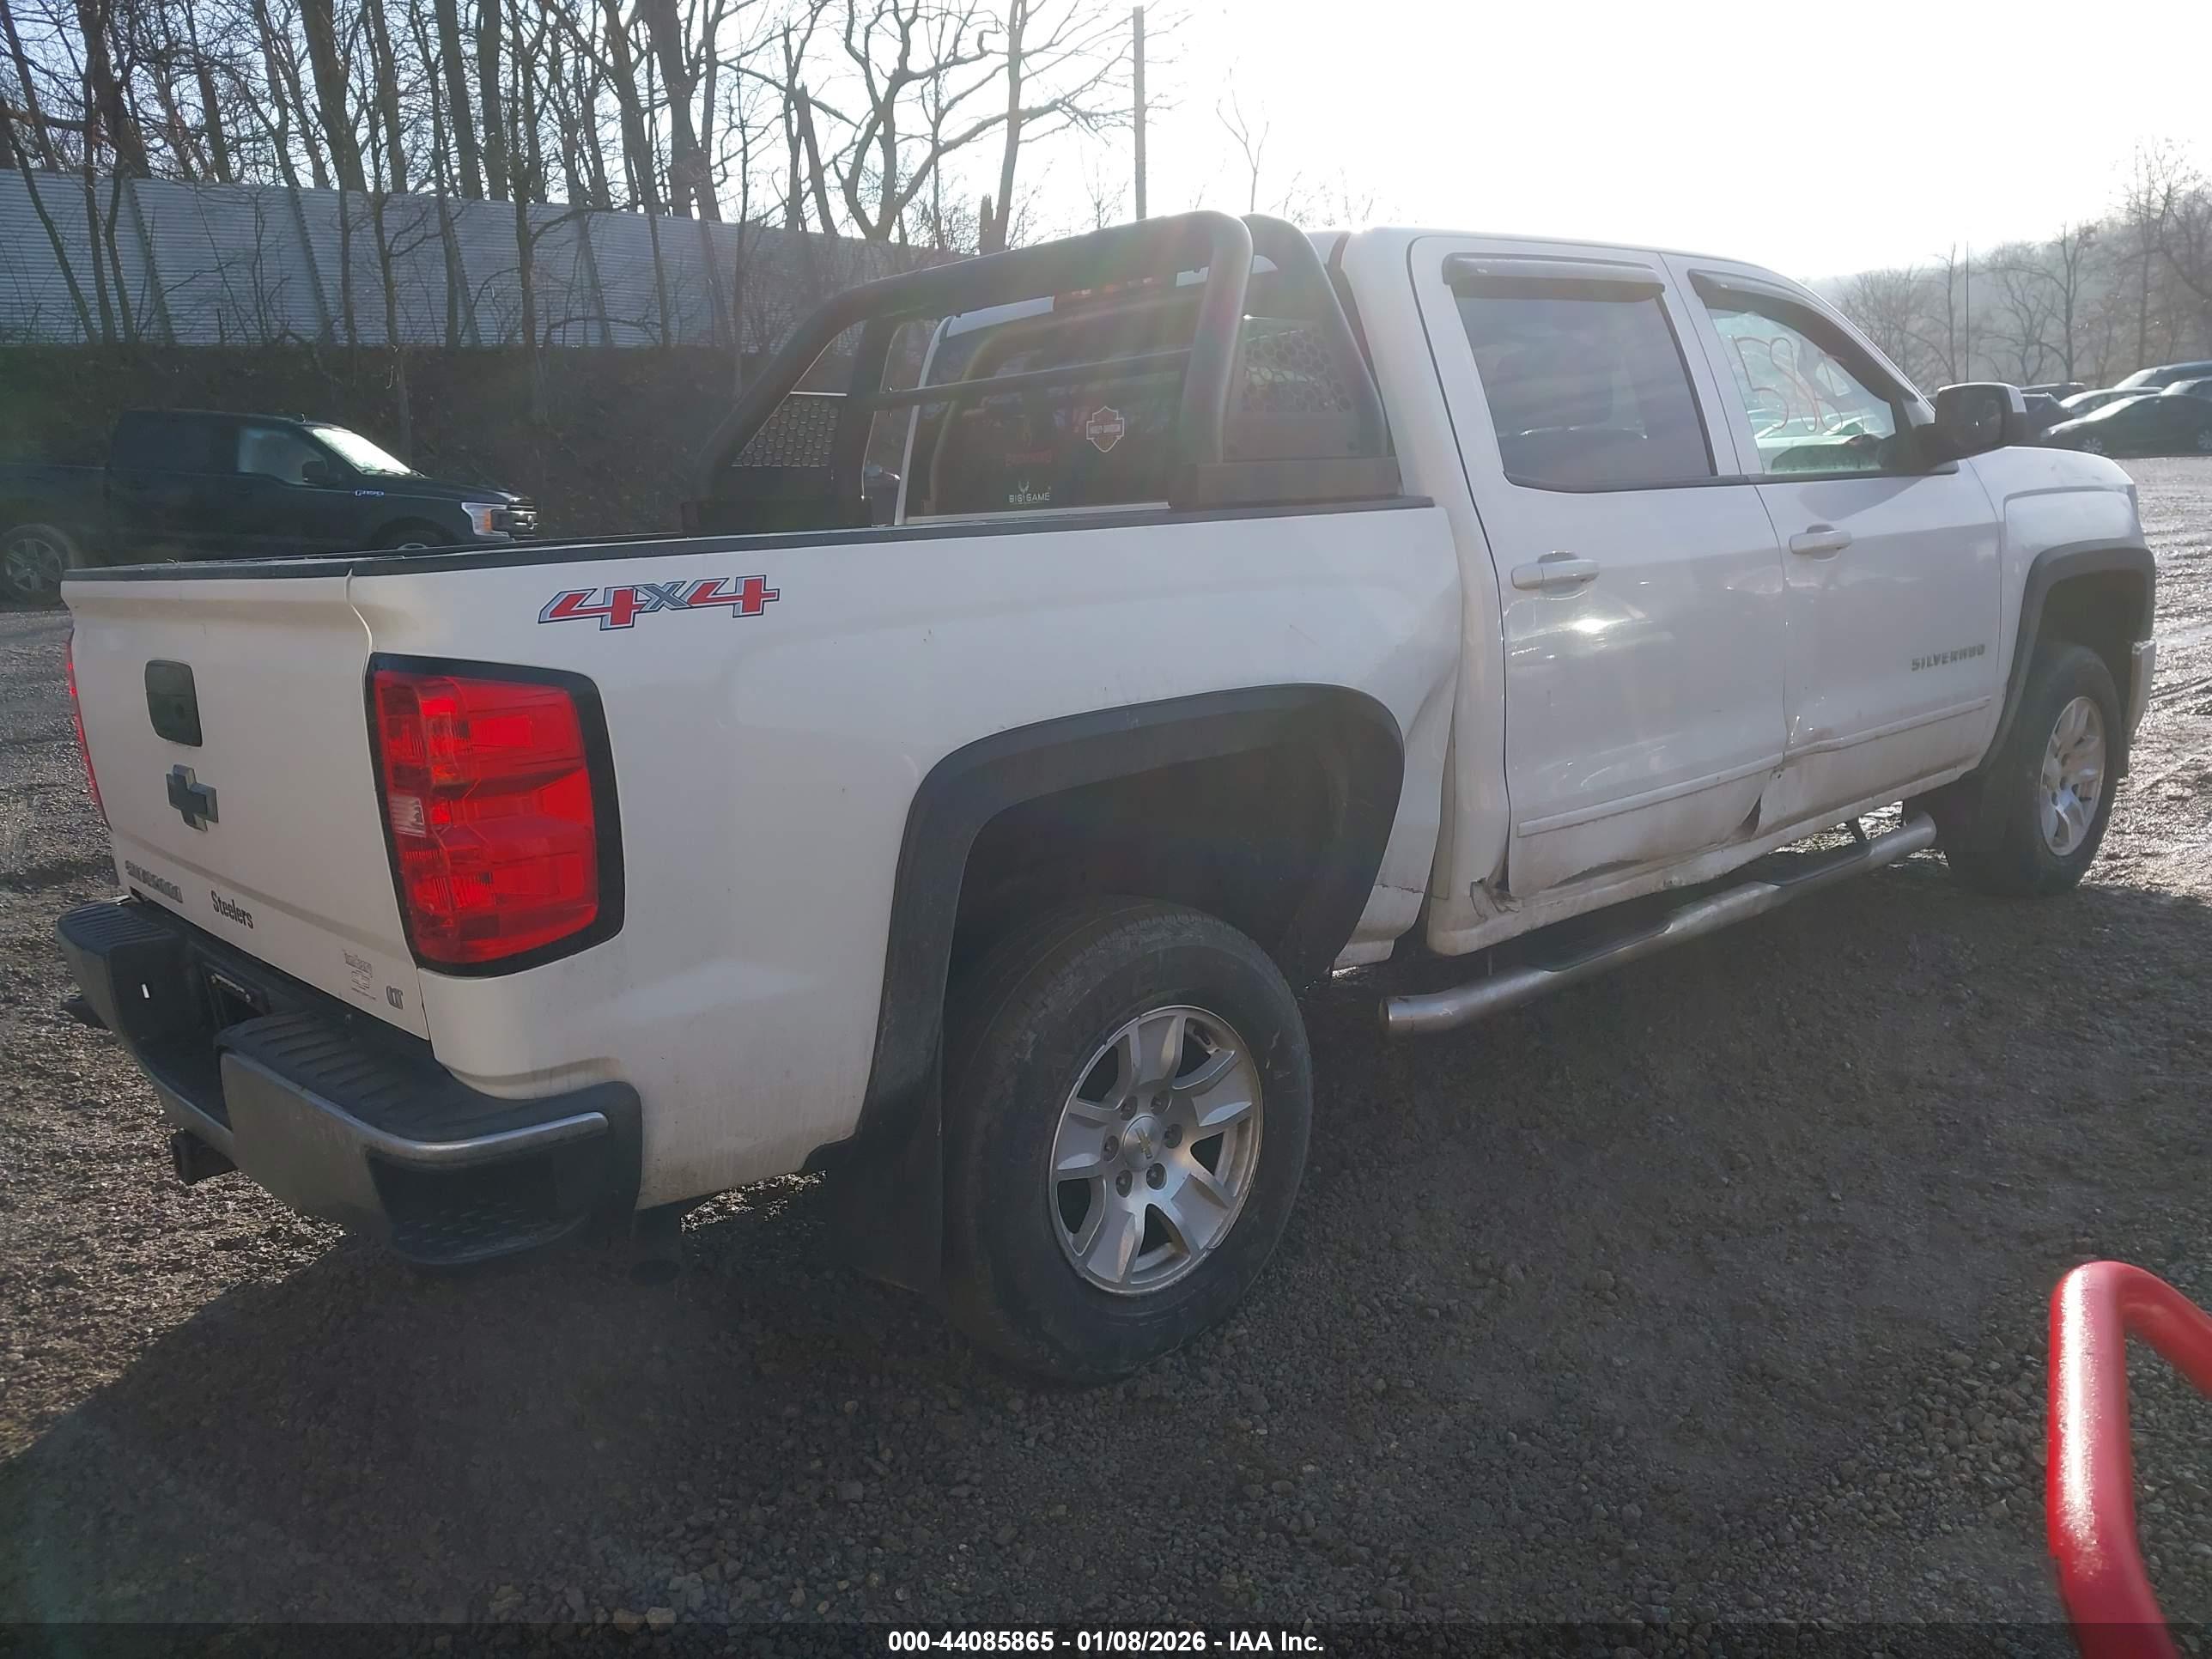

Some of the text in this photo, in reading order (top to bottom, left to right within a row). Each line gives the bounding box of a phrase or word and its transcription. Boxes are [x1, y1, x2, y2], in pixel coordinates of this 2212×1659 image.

[1009, 492, 1050, 503] BIG GAME
[211, 890, 254, 929] Steelers
